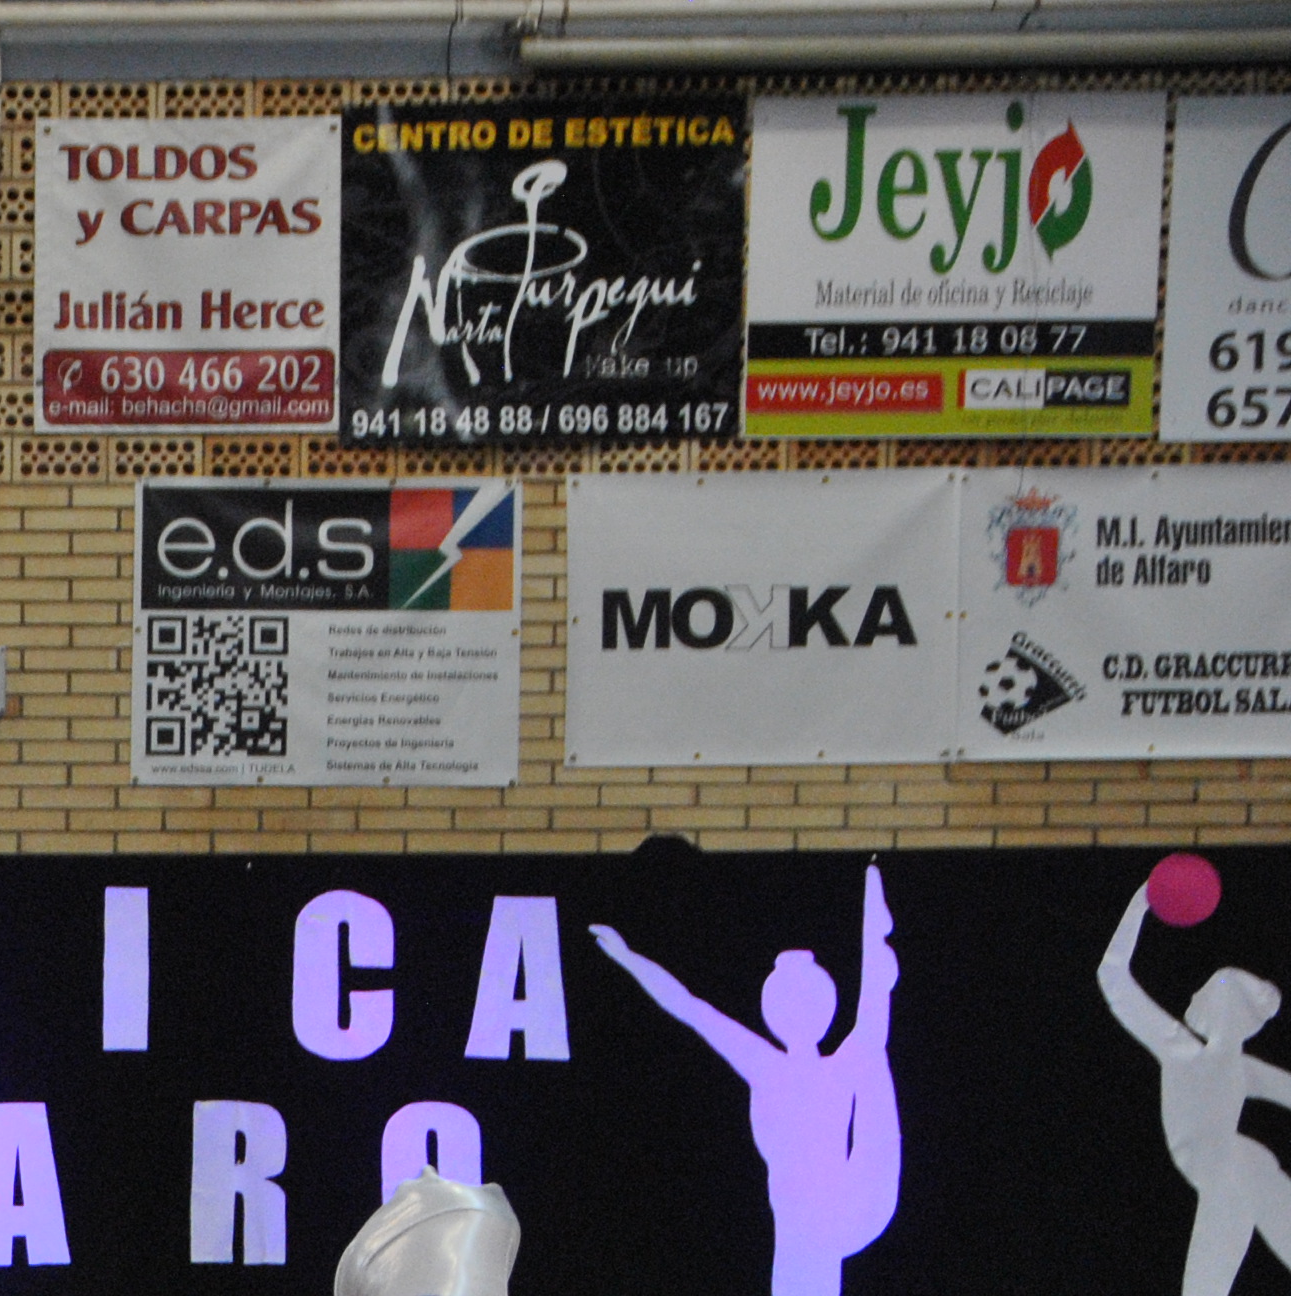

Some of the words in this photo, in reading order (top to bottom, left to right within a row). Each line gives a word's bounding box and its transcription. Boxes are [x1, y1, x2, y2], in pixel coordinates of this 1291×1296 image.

[353, 119, 496, 153] CENTRO
[508, 118, 553, 150] DE
[564, 111, 735, 148] ESTÉTICA
[59, 144, 258, 181] TOLDOS
[810, 101, 1093, 274] Jeyjo
[75, 209, 105, 246] y
[120, 198, 322, 236] CARPAS
[816, 279, 895, 306] Material
[900, 279, 921, 305] de
[927, 278, 989, 306] oficina
[995, 284, 1006, 310] y
[1012, 278, 1094, 309] Reciclaje
[54, 289, 182, 331] Julián
[201, 289, 324, 330] Herce
[882, 327, 938, 354] 941
[953, 326, 988, 354] 18
[1000, 325, 1037, 353] 08
[1049, 325, 1088, 353] 77
[100, 355, 165, 393] 630
[178, 355, 243, 393] 466
[257, 354, 321, 393] 202
[757, 377, 929, 405] www.jeyjo.es
[48, 398, 115, 416] e-mail:
[122, 396, 330, 419] behacha@gmail.com
[352, 409, 401, 439] 941
[414, 408, 447, 437] 18
[455, 406, 490, 436] 48
[499, 405, 534, 434] 88
[559, 404, 609, 433] 696
[618, 403, 669, 432] 884
[679, 402, 729, 431] 167
[157, 499, 374, 580] e.d.s
[1096, 514, 1145, 547] M.I.
[1096, 555, 1125, 587] de
[1133, 554, 1212, 587] Alfaro
[243, 584, 253, 601] y
[328, 624, 363, 636] Redes
[366, 624, 379, 636] de
[329, 648, 375, 661] Trabajos
[393, 647, 415, 658] Alta
[427, 647, 452, 661] Baja
[1102, 652, 1148, 680] C.D.
[327, 669, 408, 681] Mantenimiento
[410, 669, 424, 681] de
[327, 692, 378, 703] Servicios
[1120, 688, 1231, 716] FUTBOL
[1234, 686, 1291, 715] SAL
[378, 714, 442, 726] Renovables
[326, 736, 382, 751] Proyectos
[384, 737, 398, 748] de
[326, 759, 376, 771] Sistemas
[379, 760, 392, 771] de
[395, 759, 417, 771] Alta
